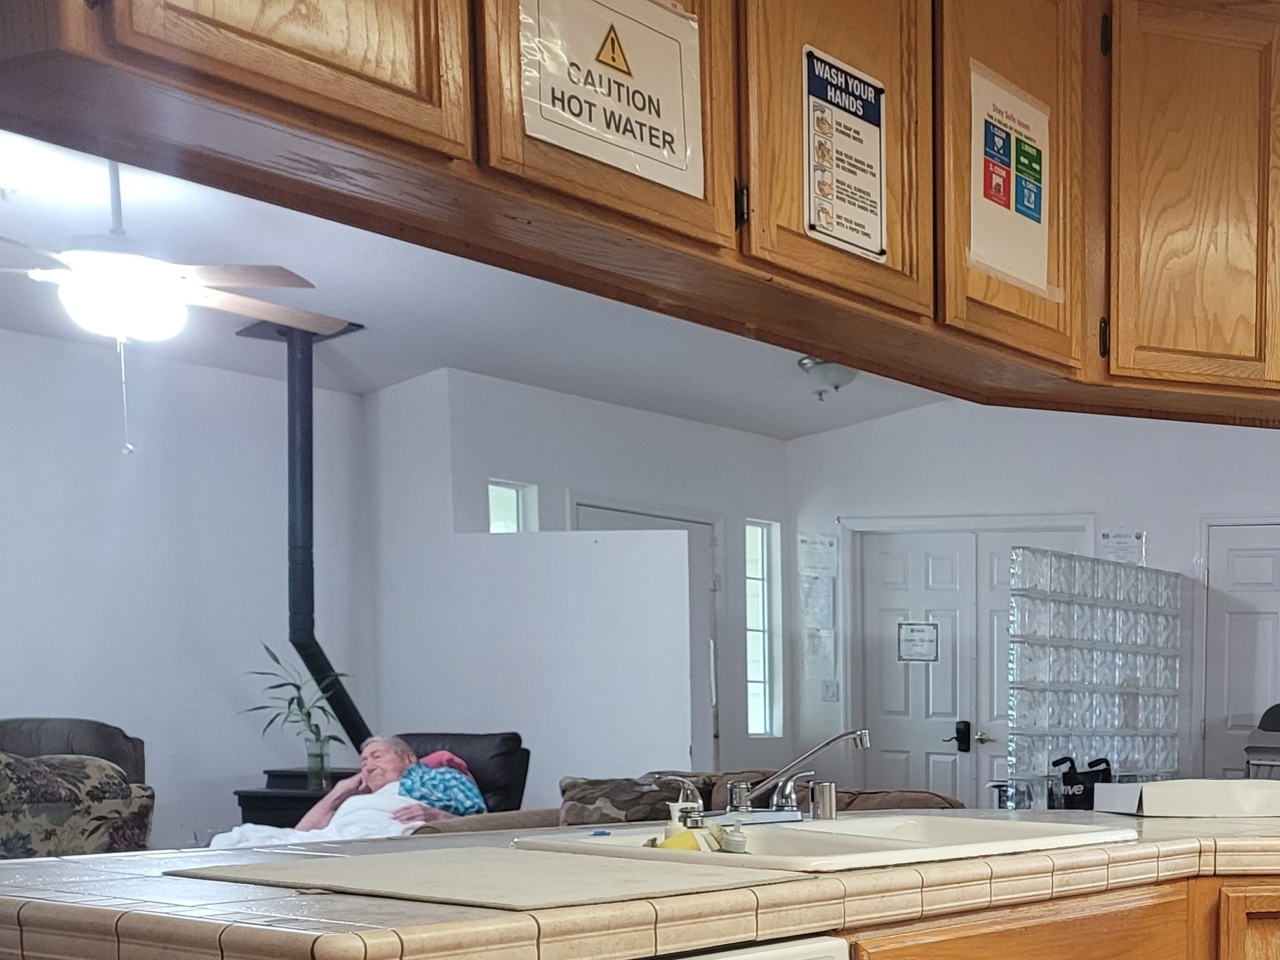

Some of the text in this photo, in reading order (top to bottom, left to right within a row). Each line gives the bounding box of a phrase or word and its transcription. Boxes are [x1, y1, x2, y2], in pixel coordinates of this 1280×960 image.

[567, 61, 662, 119] CAUTION
[813, 58, 876, 104] WASH YOUR
[826, 84, 864, 117] HANDS
[550, 86, 677, 155] HOT WATER
